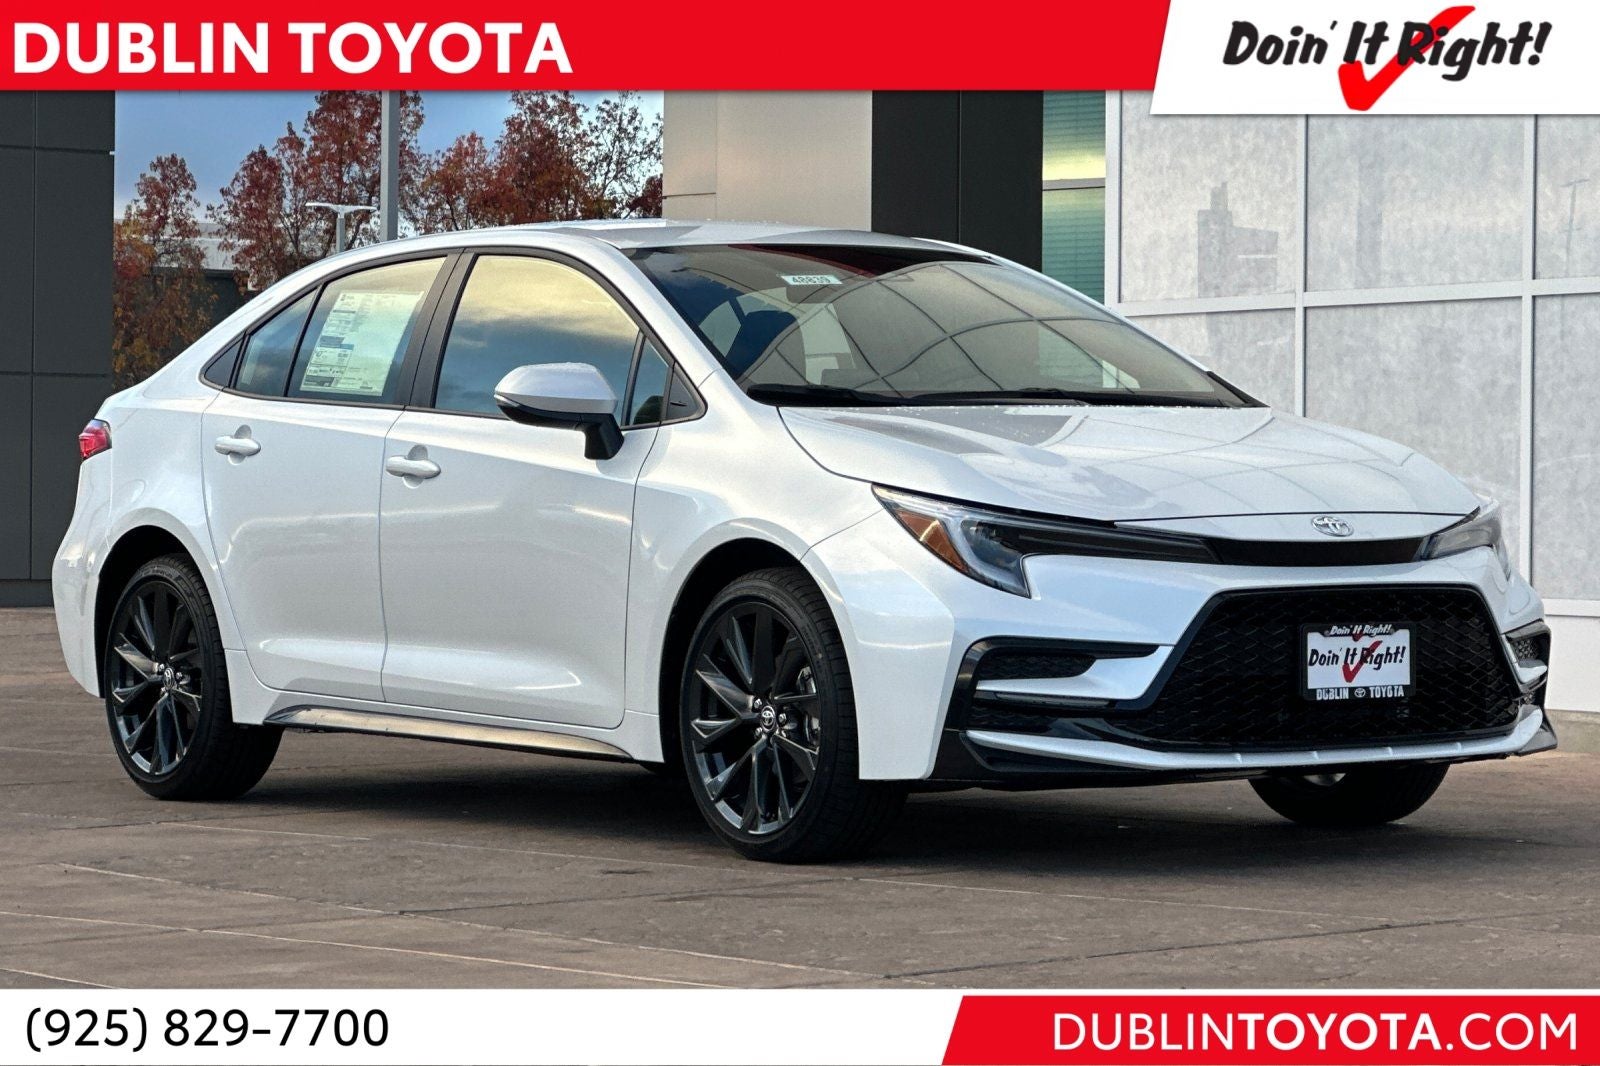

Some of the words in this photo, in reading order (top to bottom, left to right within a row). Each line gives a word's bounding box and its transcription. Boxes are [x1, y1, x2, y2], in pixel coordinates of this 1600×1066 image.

[1353, 624, 1362, 634] It
[1363, 623, 1393, 637] Right!
[1308, 647, 1342, 667] Doin'
[1344, 646, 1358, 665] It
[1360, 645, 1407, 671] Right!
[1316, 687, 1350, 701] DUBLIN
[1369, 685, 1405, 699] TOYOTA
